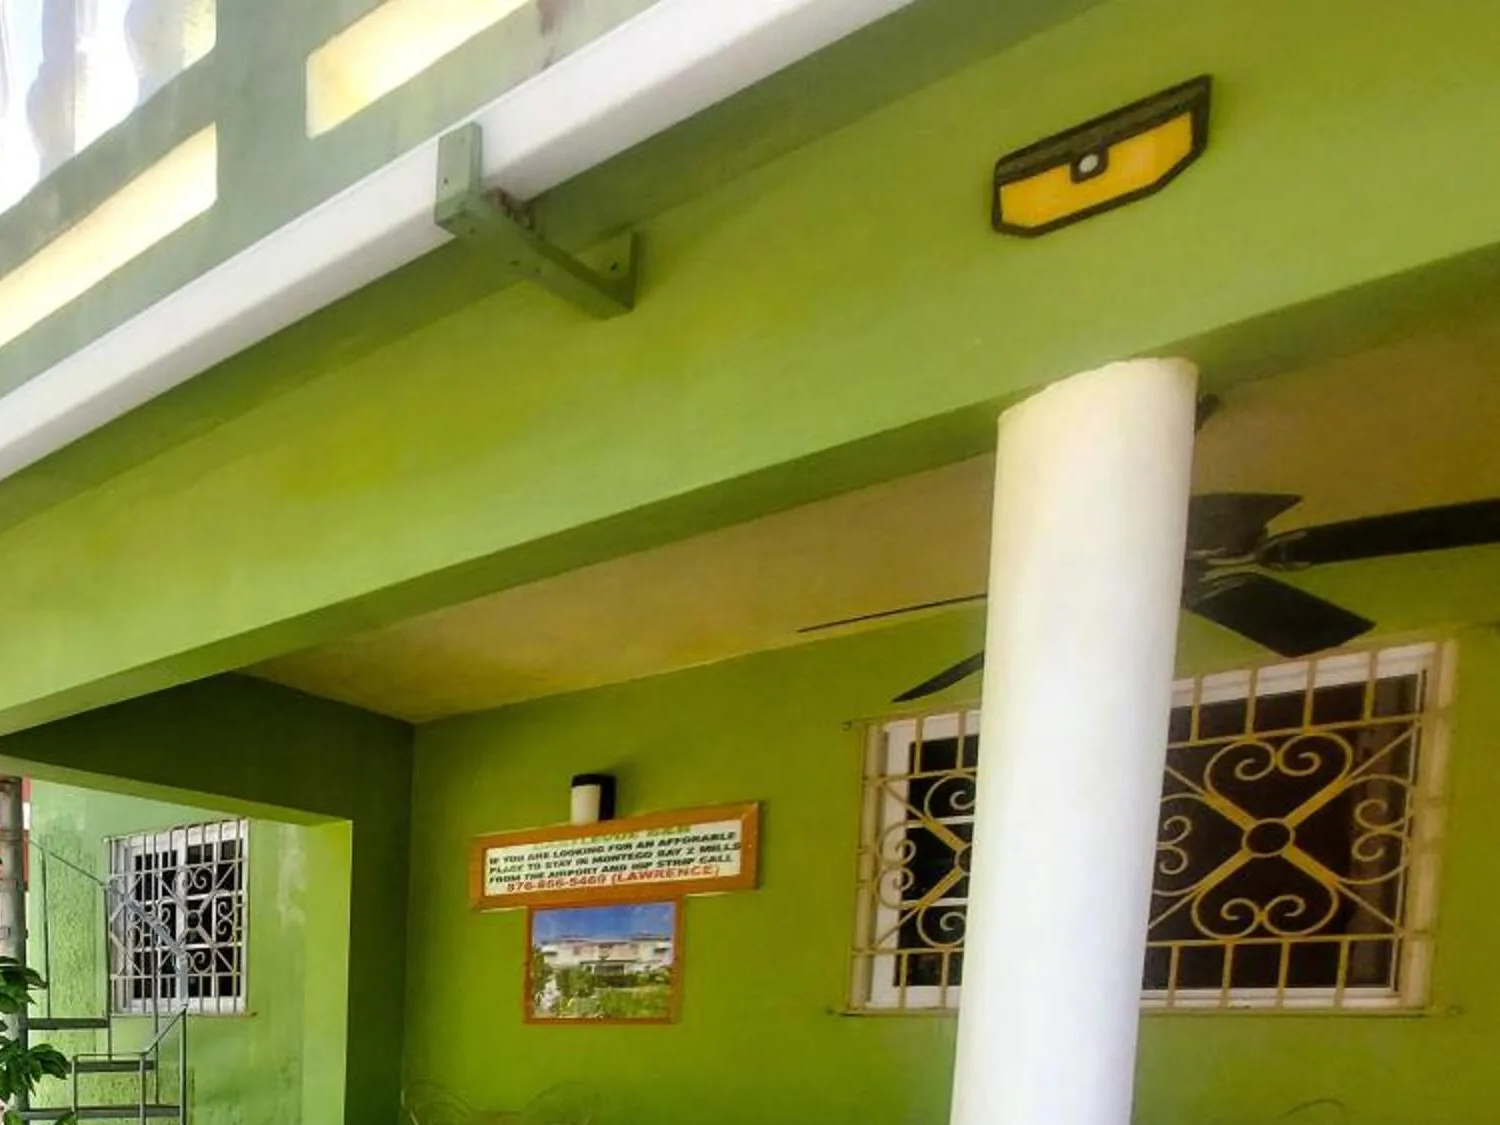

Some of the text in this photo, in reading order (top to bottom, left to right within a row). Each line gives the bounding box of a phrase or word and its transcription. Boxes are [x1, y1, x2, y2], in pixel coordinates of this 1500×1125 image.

[489, 865, 522, 874] PLACE
[528, 862, 541, 870] TO
[546, 860, 572, 869] STAY
[592, 850, 653, 864] MONTEGO
[657, 847, 683, 857] BAY
[528, 852, 549, 860] ARE
[554, 845, 604, 858] LOOKING
[608, 843, 632, 852] FOR
[636, 840, 655, 848] AN
[489, 874, 521, 883] FROM
[525, 872, 544, 880] THE
[548, 868, 598, 878] AIRPORT
[602, 864, 627, 873] AND
[699, 854, 732, 863] CALL
[612, 864, 720, 885] (LAWRENCE)
